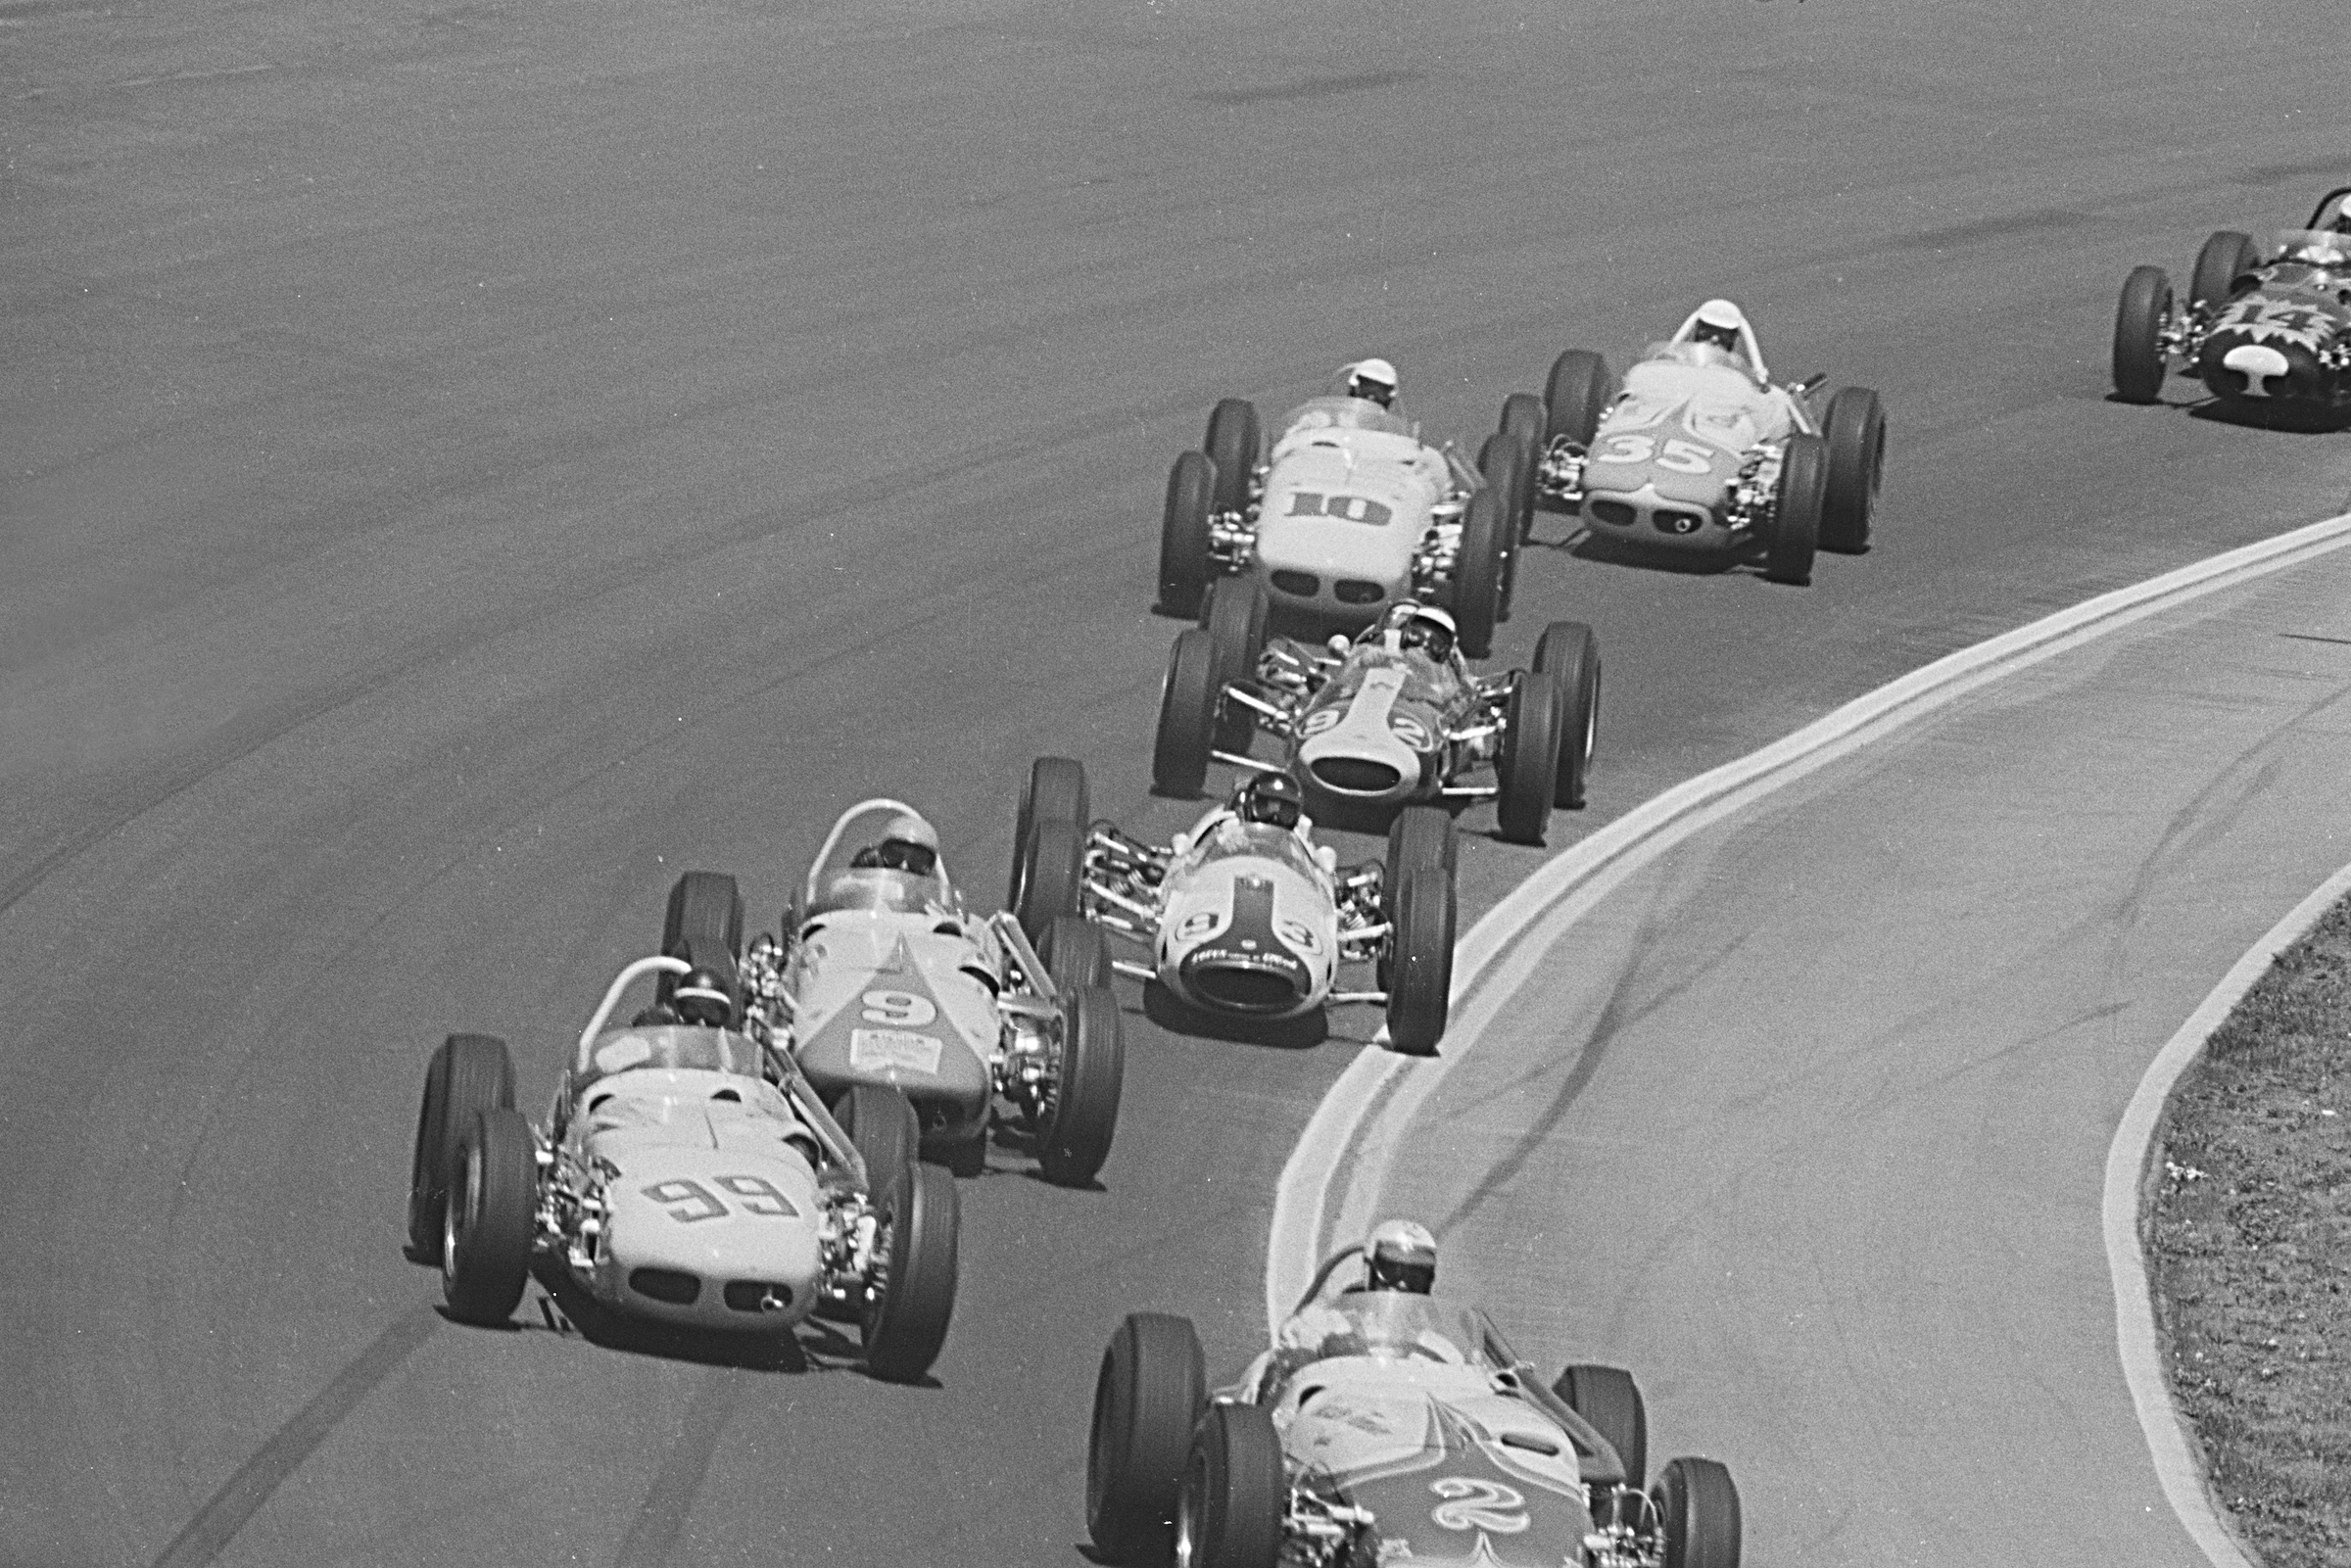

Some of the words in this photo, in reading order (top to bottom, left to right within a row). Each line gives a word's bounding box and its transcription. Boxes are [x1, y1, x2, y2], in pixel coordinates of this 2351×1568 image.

[1599, 434, 1714, 475] 35
[1283, 491, 1393, 527] 10
[862, 990, 937, 1026] 9
[640, 1173, 800, 1223] 99
[1428, 1477, 1531, 1534] 2
